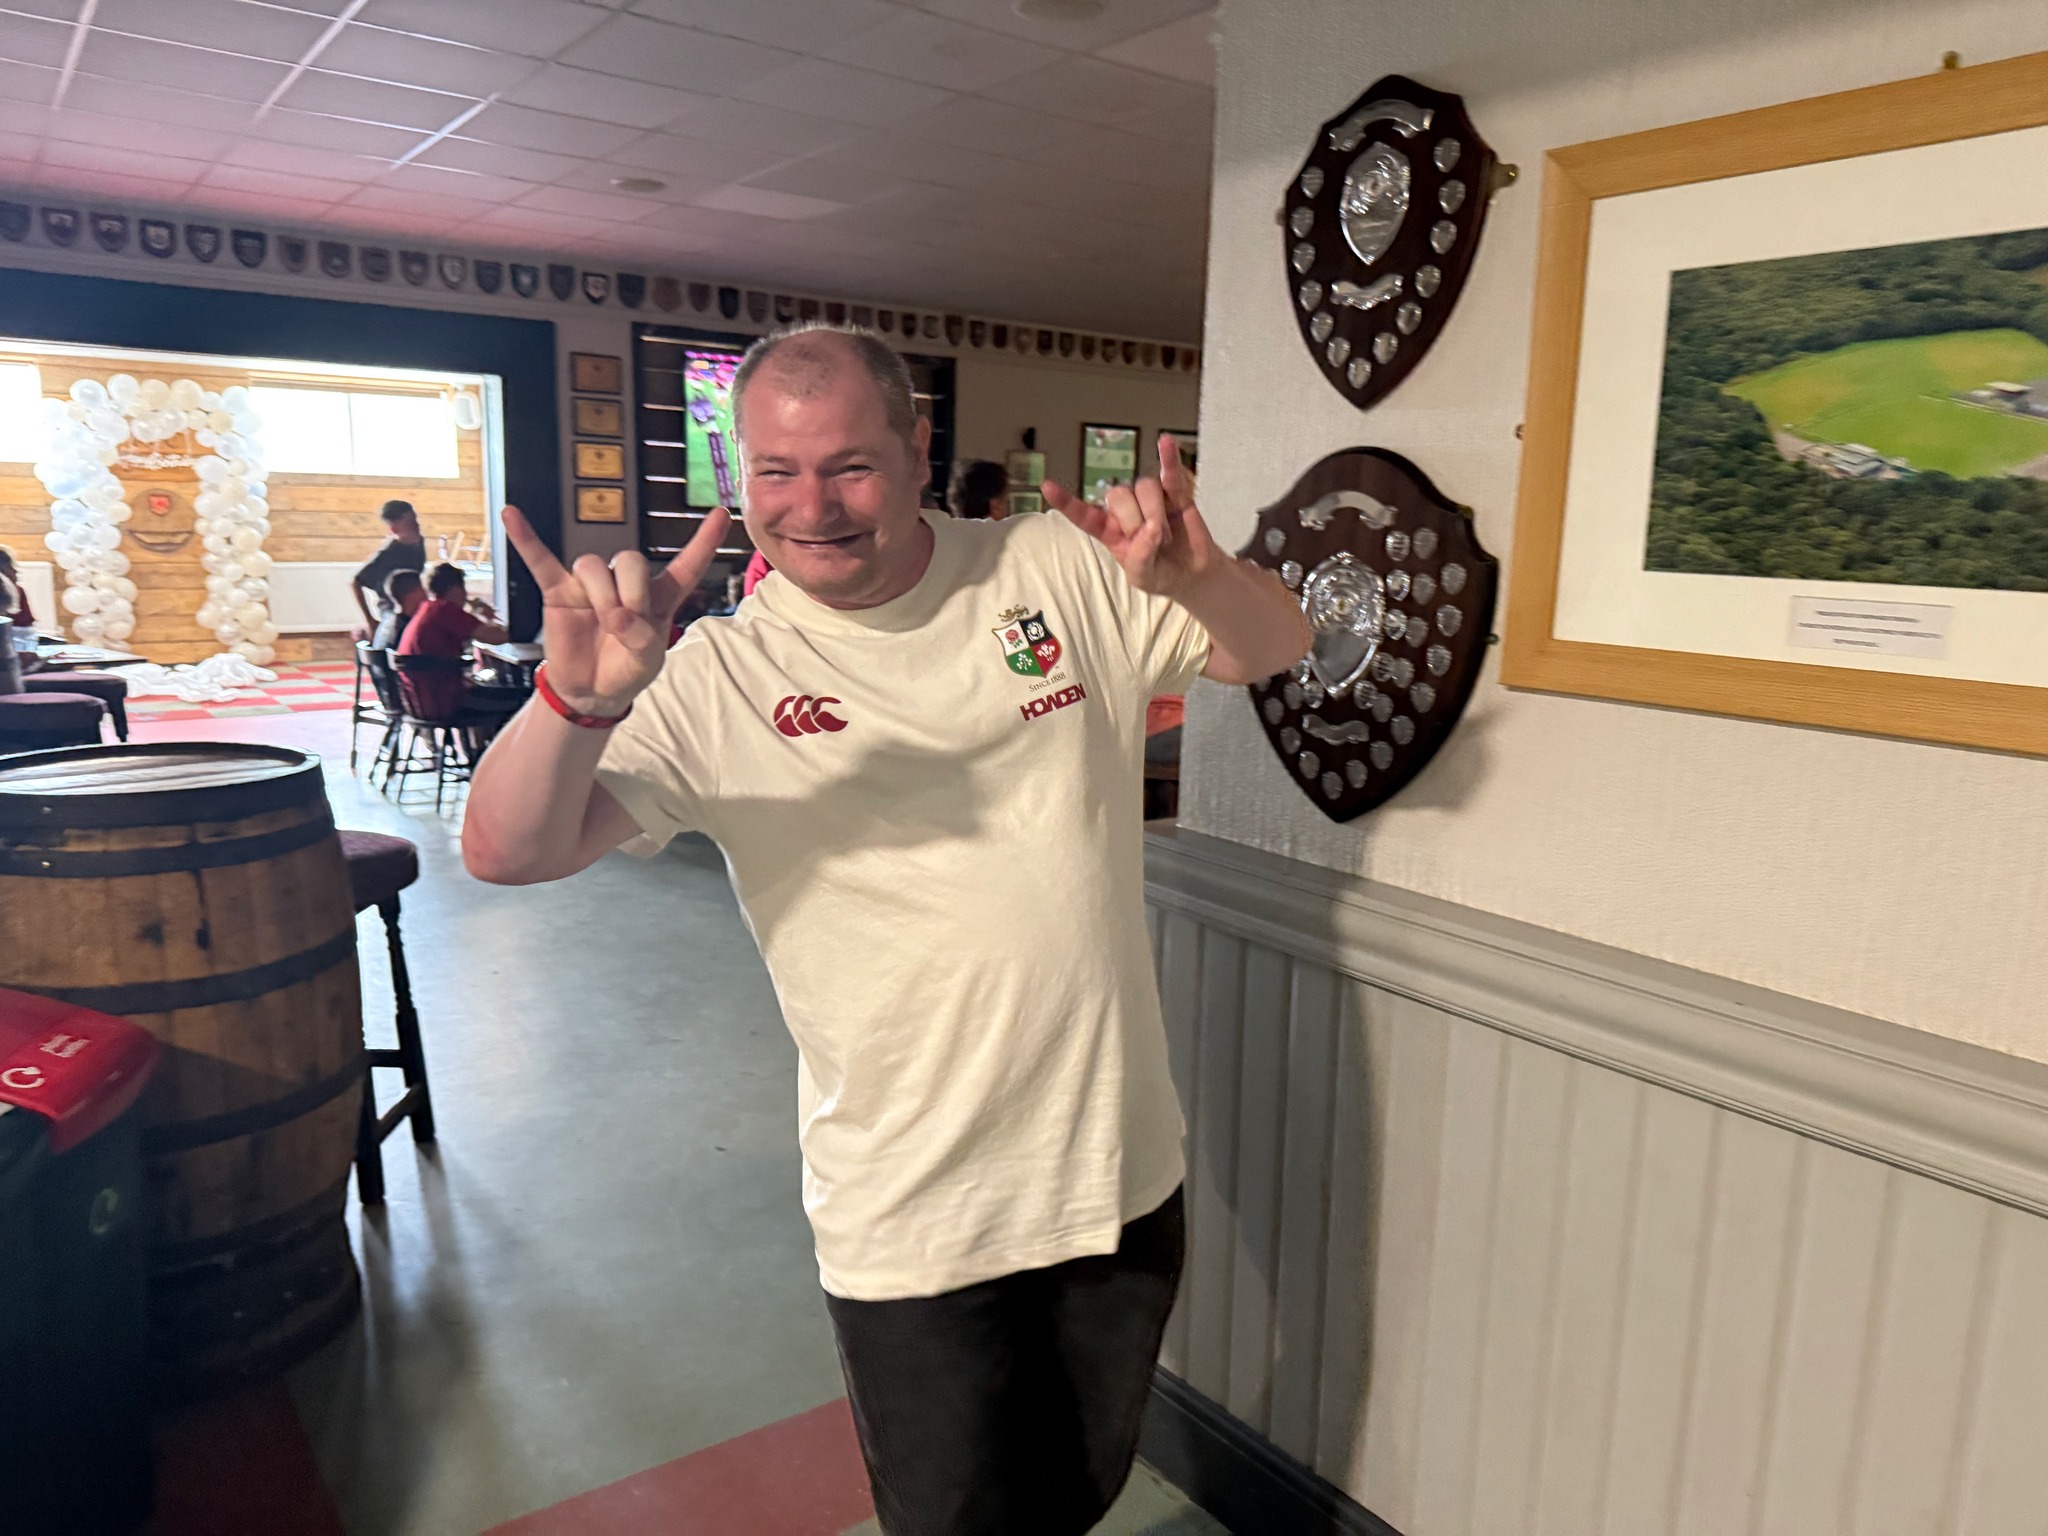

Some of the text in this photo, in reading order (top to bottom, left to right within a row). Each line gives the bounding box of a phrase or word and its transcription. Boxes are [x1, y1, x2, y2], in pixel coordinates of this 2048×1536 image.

[1028, 672, 1067, 692] SINCE 1888
[1020, 683, 1087, 721] HOWDEN
